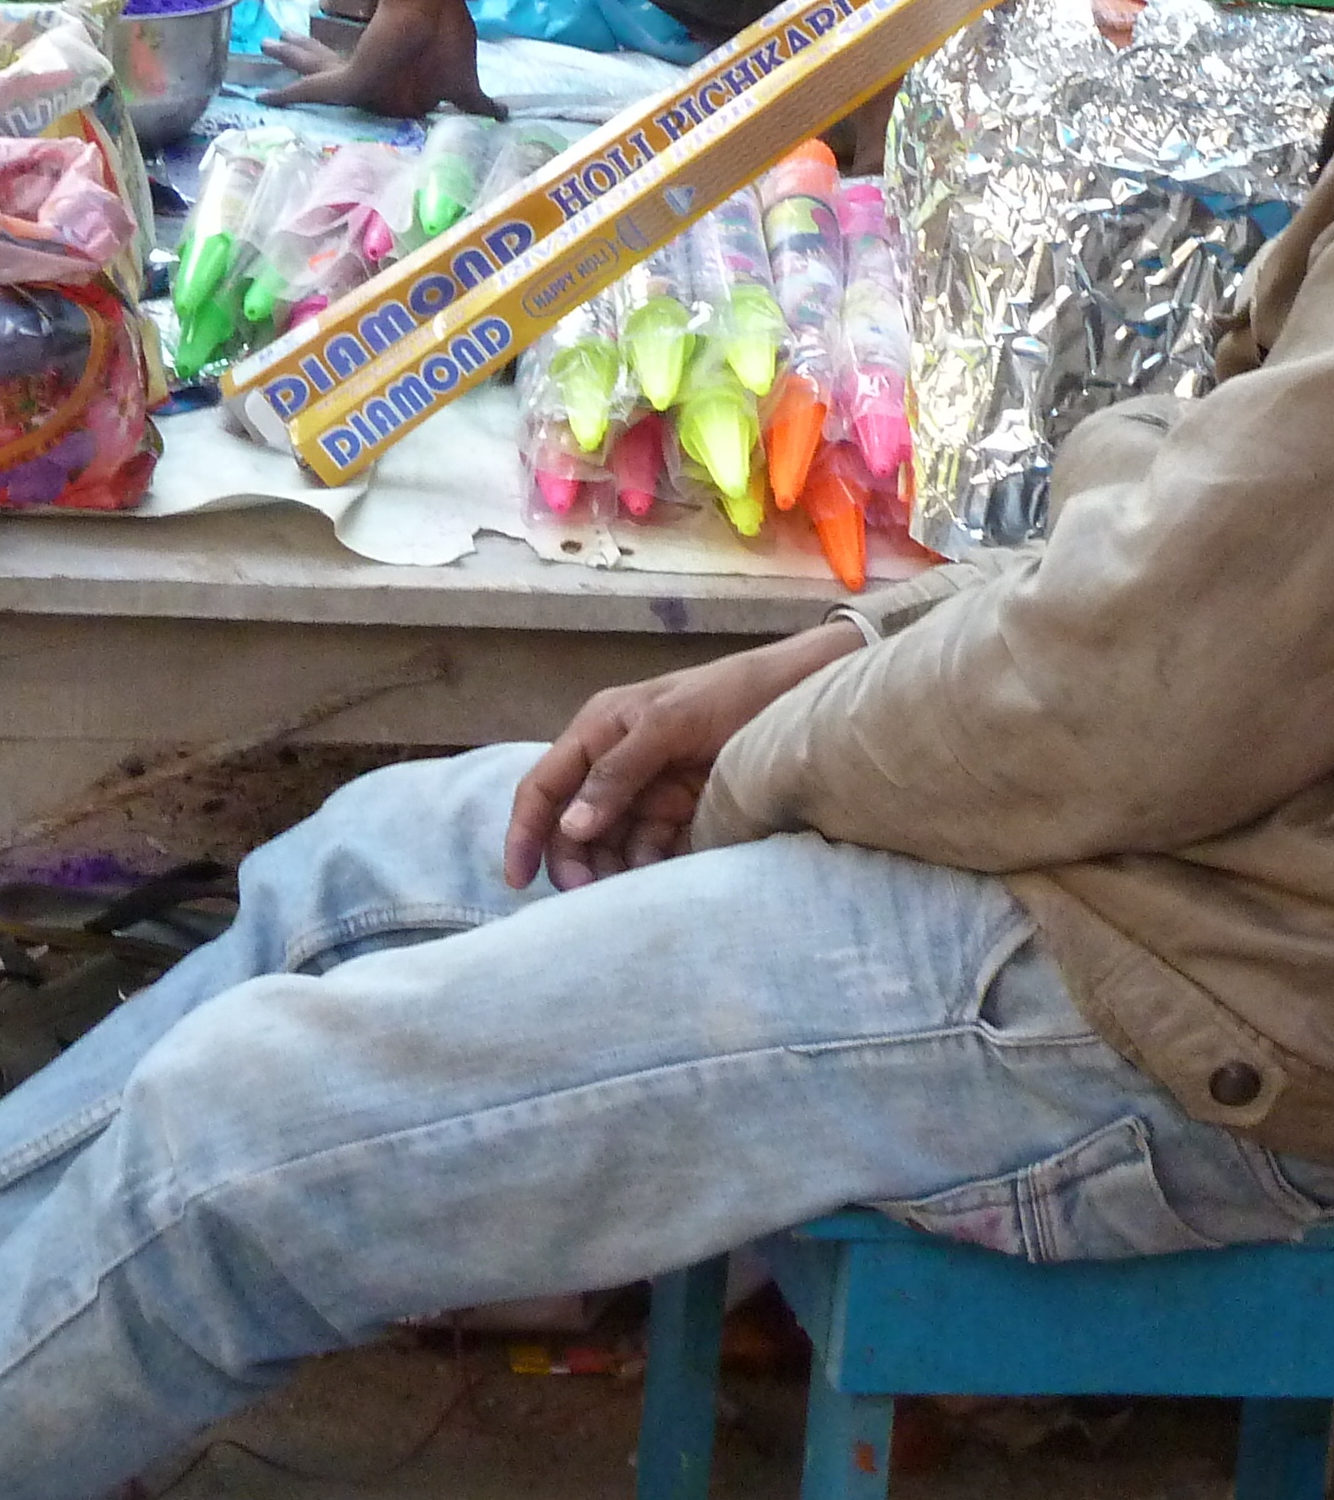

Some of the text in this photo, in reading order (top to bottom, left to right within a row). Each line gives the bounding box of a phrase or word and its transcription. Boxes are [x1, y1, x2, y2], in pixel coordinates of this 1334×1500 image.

[259, 219, 535, 421] DIAMOND
[546, 128, 657, 223] HOLI
[318, 245, 610, 471] DIAMOND HAPPY HOLI
